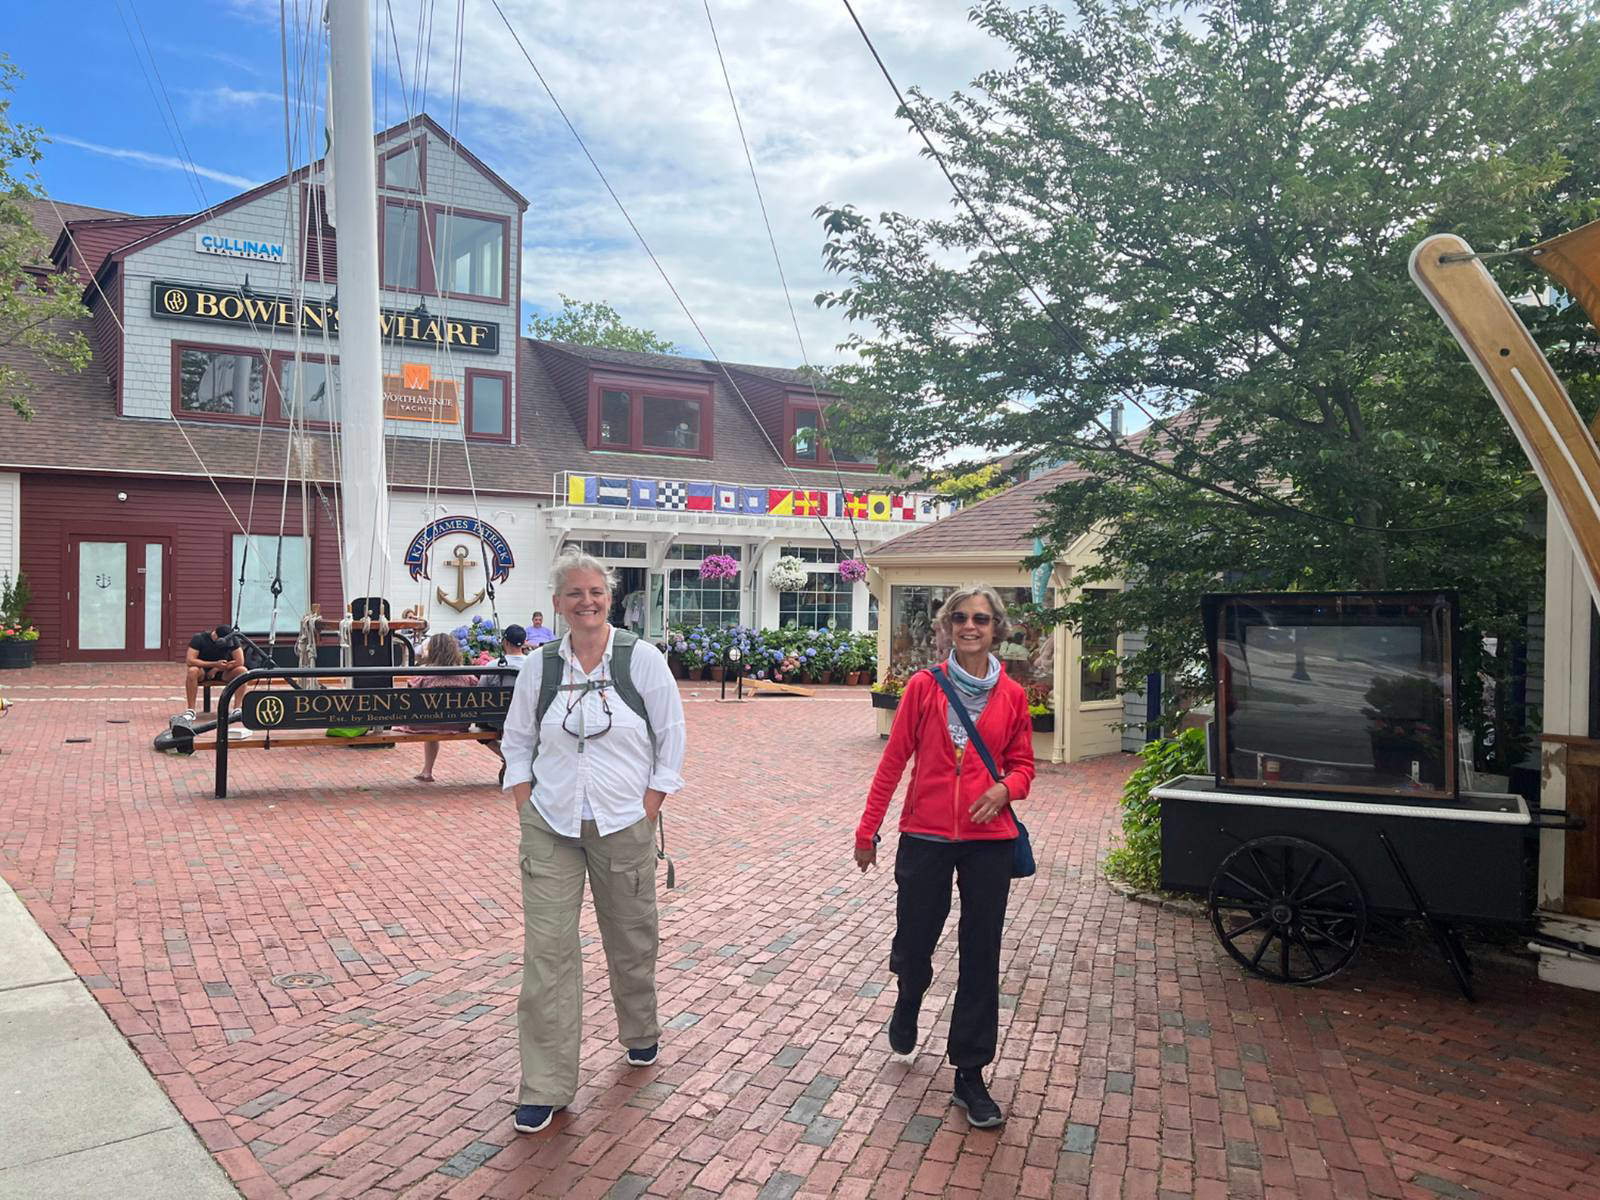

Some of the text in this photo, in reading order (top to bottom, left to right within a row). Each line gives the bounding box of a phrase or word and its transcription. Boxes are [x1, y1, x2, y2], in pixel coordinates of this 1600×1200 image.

[201, 235, 283, 257] CULLINAN
[400, 405, 433, 414] YACHTS
[433, 520, 469, 537] JAMES
[473, 522, 509, 560] PATRICK
[295, 691, 511, 713] BOWEN'S WHARF
[352, 714, 362, 722] by
[368, 711, 407, 721] Benedict
[411, 711, 444, 720] Arnold
[448, 711, 457, 719] in
